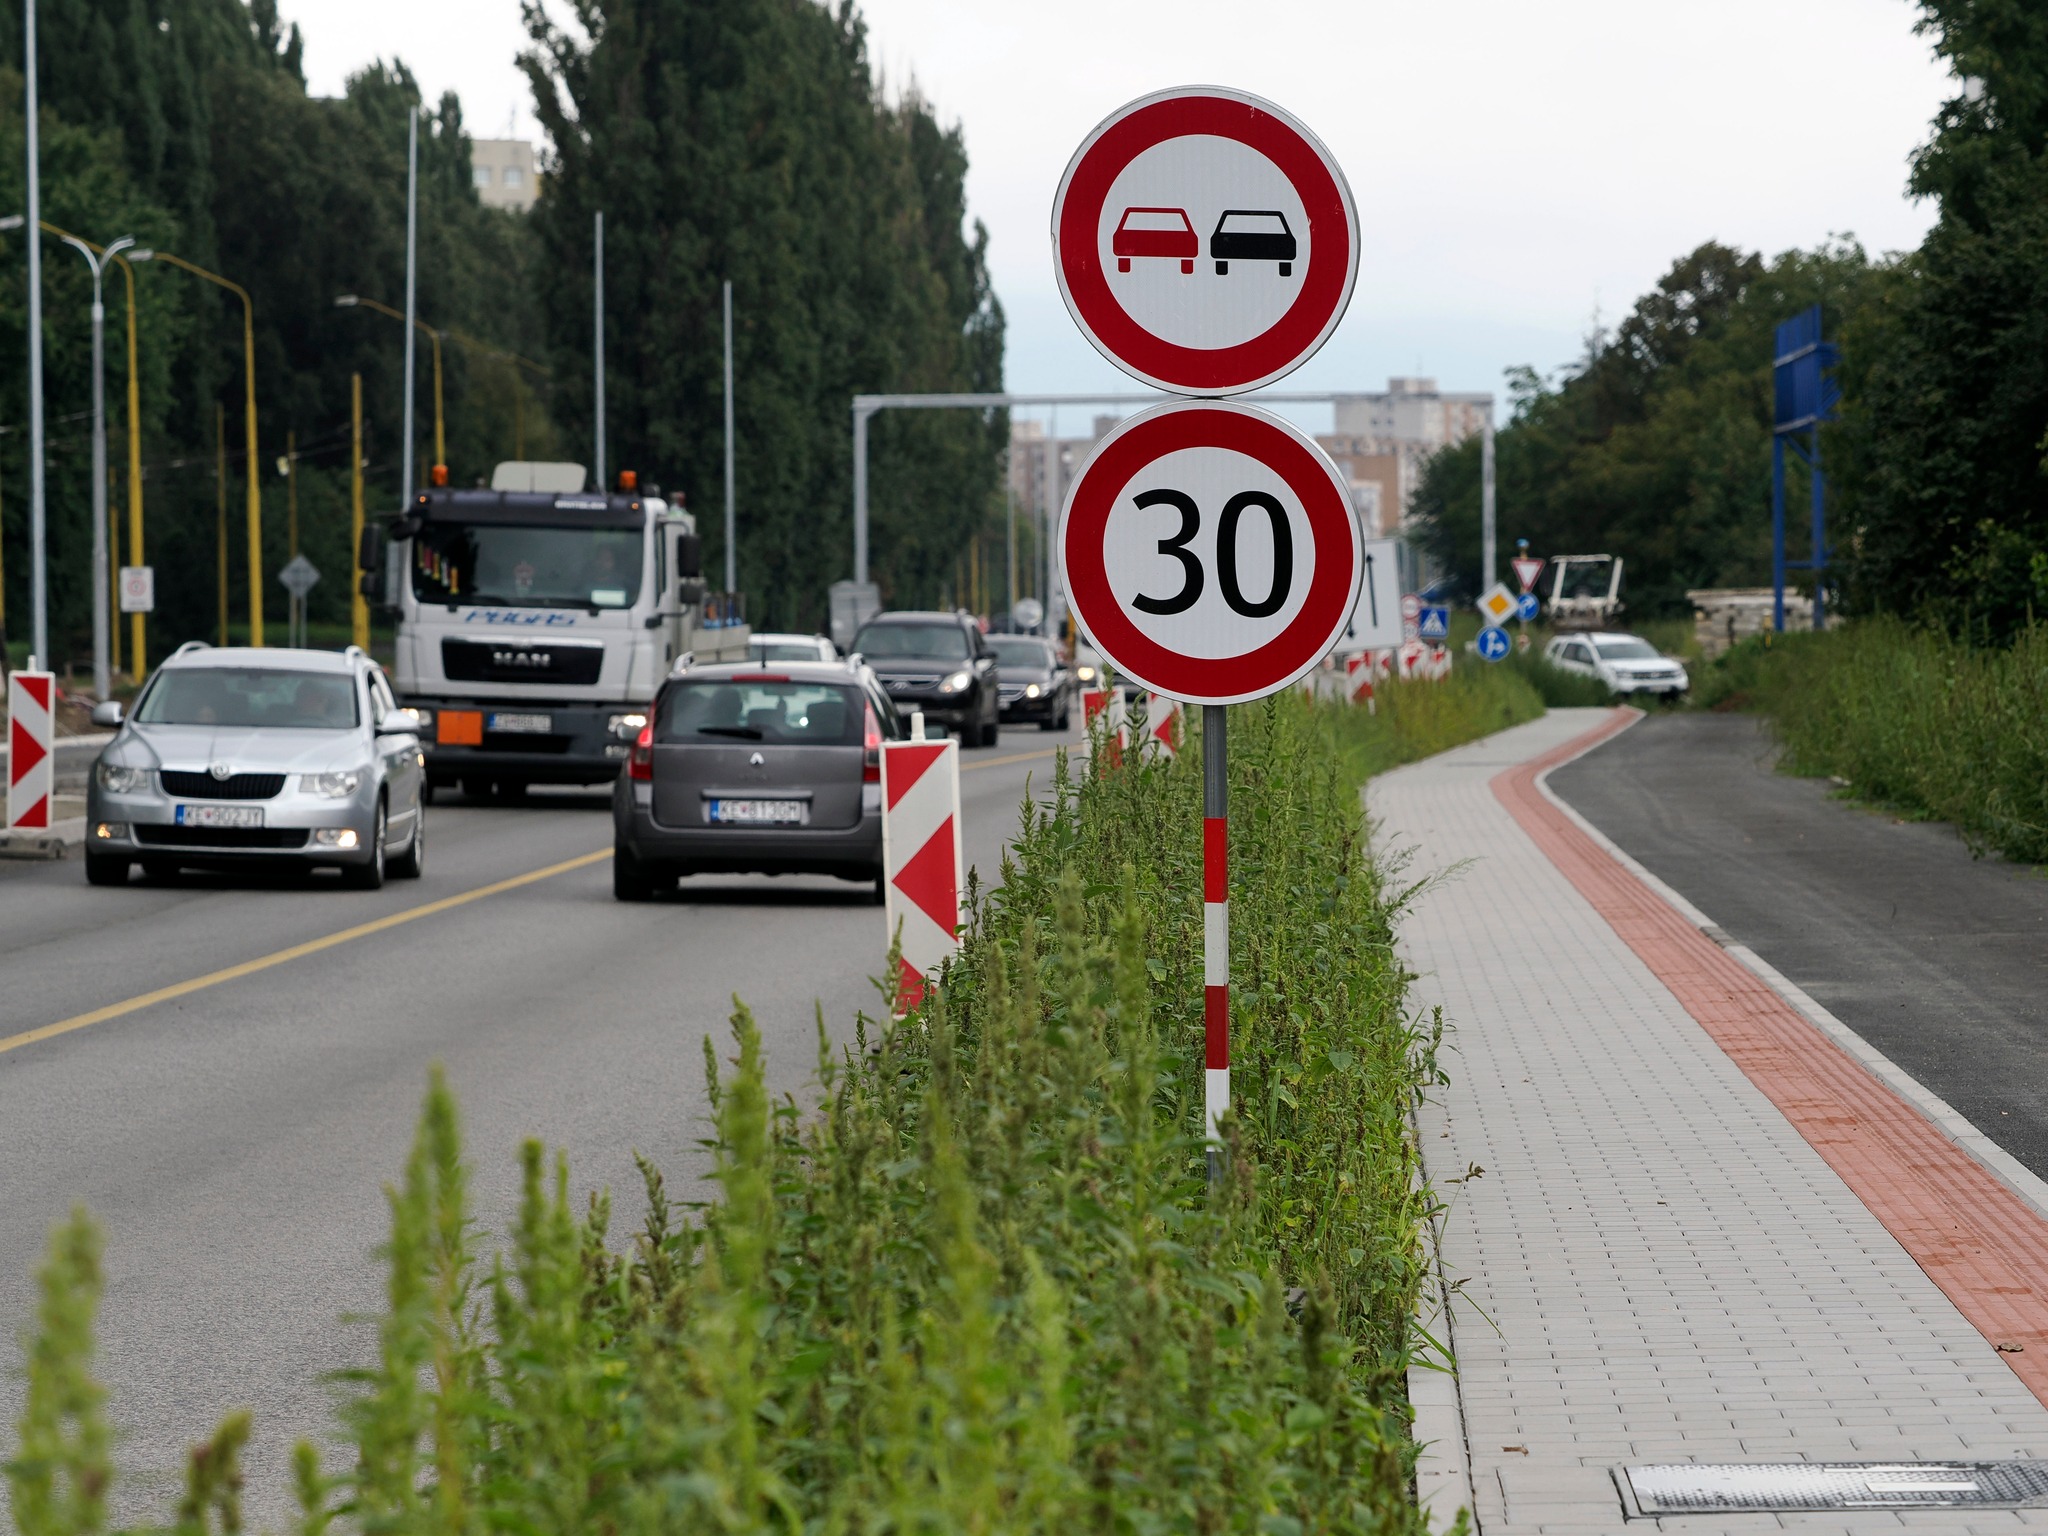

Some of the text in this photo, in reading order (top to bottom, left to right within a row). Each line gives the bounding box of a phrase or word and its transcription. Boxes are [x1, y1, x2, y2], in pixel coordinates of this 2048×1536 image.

[1132, 488, 1293, 618] 30
[493, 651, 551, 667] MAN
[185, 807, 204, 825] KE
